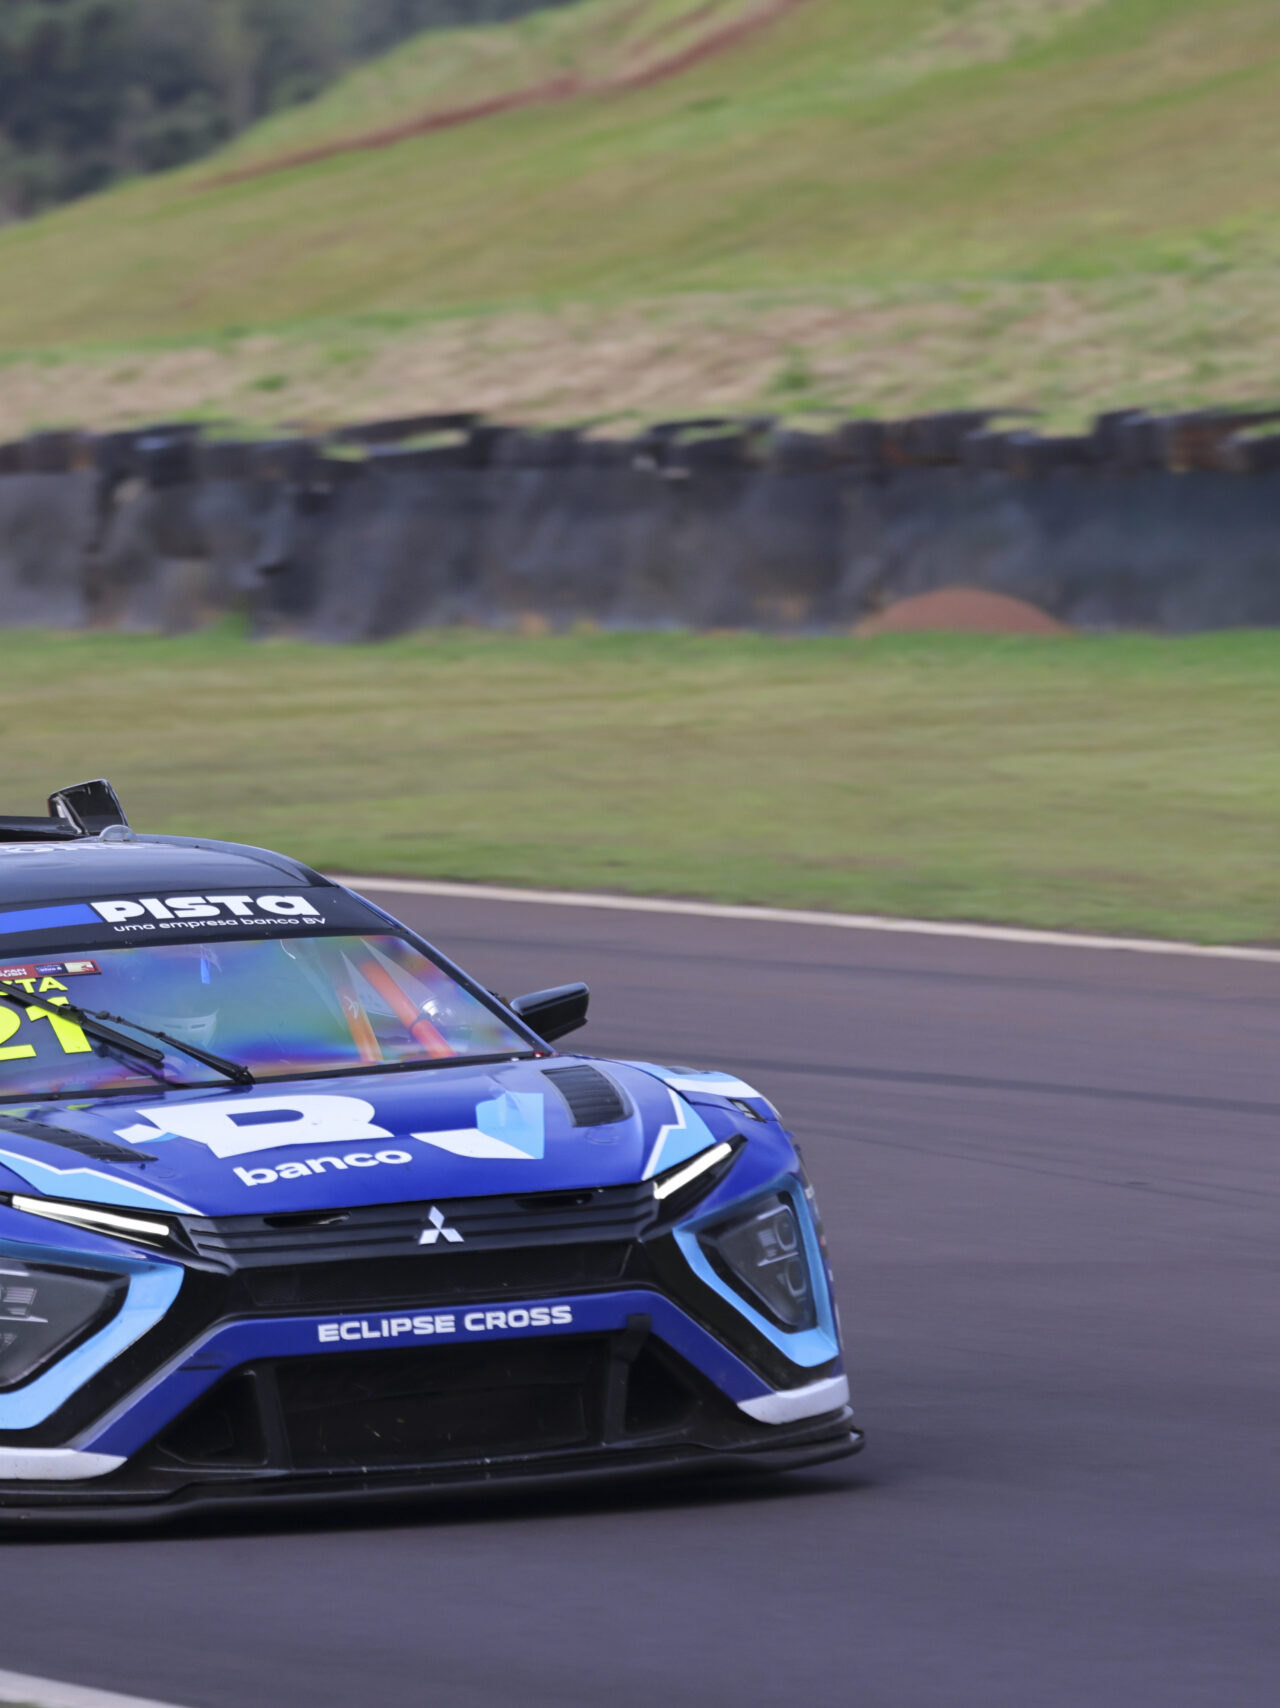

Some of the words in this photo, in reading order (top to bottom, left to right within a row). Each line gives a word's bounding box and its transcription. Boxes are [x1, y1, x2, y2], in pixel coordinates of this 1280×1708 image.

[113, 923, 156, 932] uma
[159, 918, 239, 929] empresa
[240, 917, 300, 926] banco
[302, 917, 326, 925] BV
[232, 1150, 413, 1187] banco
[318, 1314, 456, 1342] ECLIPSE
[464, 1305, 573, 1331] CROSS
